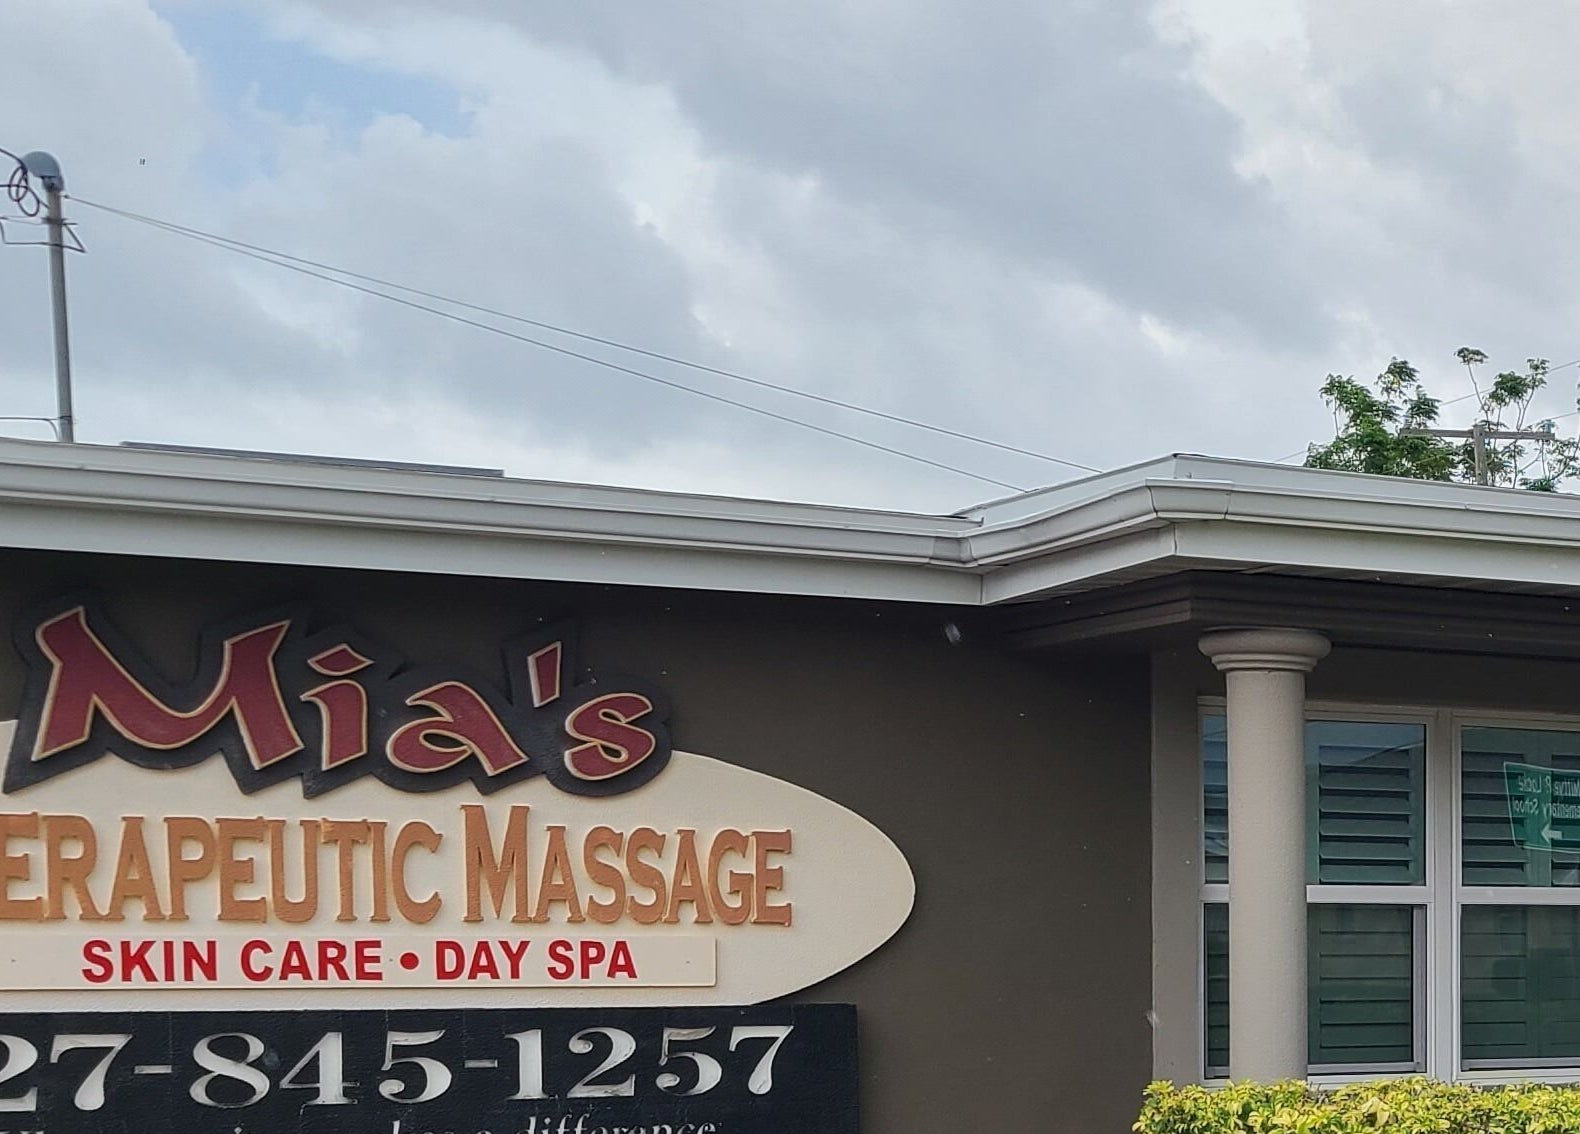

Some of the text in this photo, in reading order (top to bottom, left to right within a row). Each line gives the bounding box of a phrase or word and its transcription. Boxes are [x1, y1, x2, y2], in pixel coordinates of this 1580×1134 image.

[31, 606, 655, 781] Mia's
[0, 804, 793, 926] ERAPEUTIC MASSAGE
[82, 939, 638, 982] SKIN CARE DAY SPA
